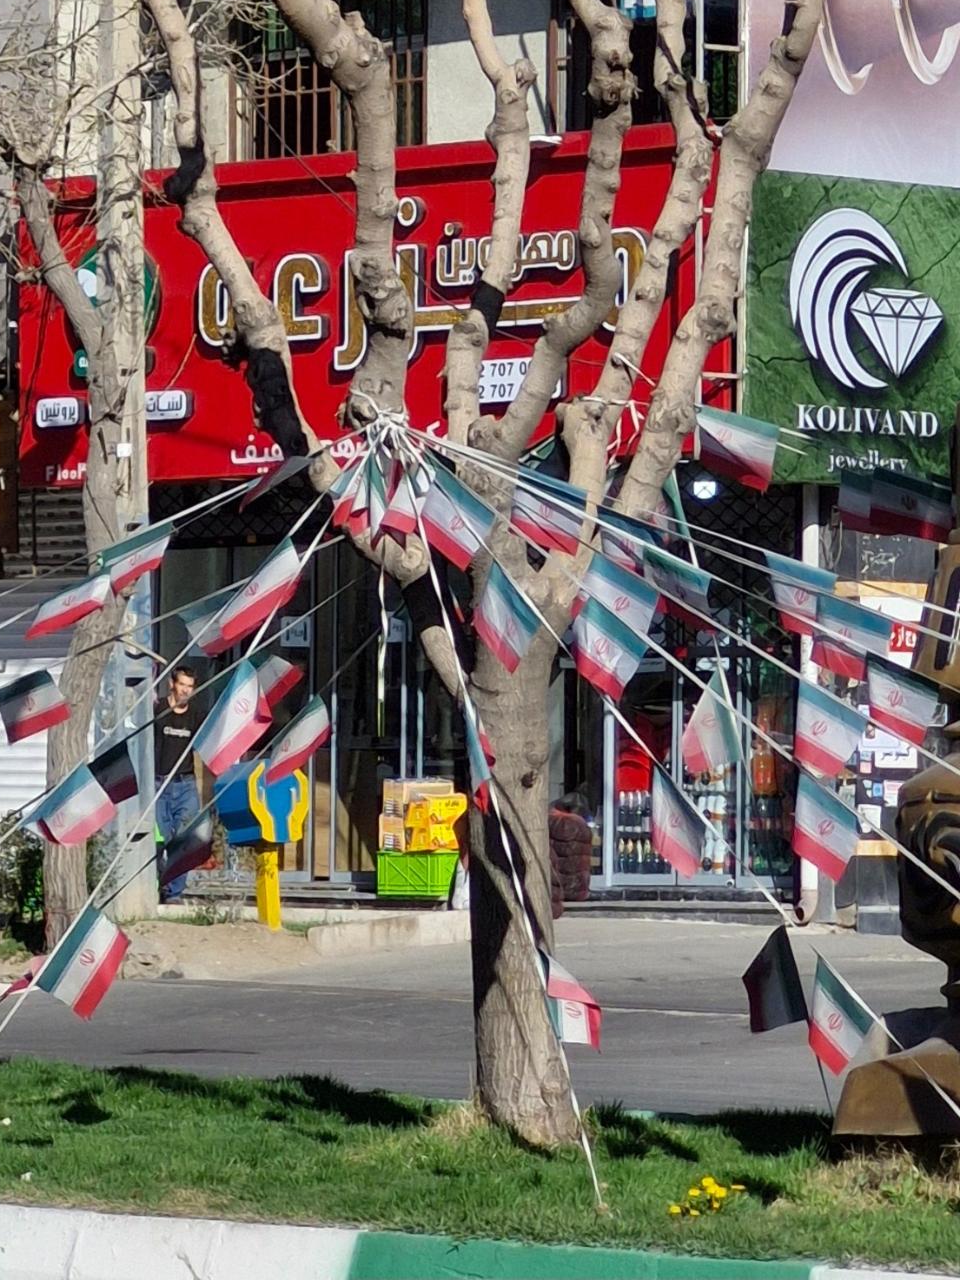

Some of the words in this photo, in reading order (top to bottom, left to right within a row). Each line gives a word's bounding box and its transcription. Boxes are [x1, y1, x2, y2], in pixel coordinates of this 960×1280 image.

[490, 362, 514, 377] 707
[490, 383, 514, 398] 707
[796, 404, 939, 437] KOLIVAND
[828, 449, 908, 472] jewellery
